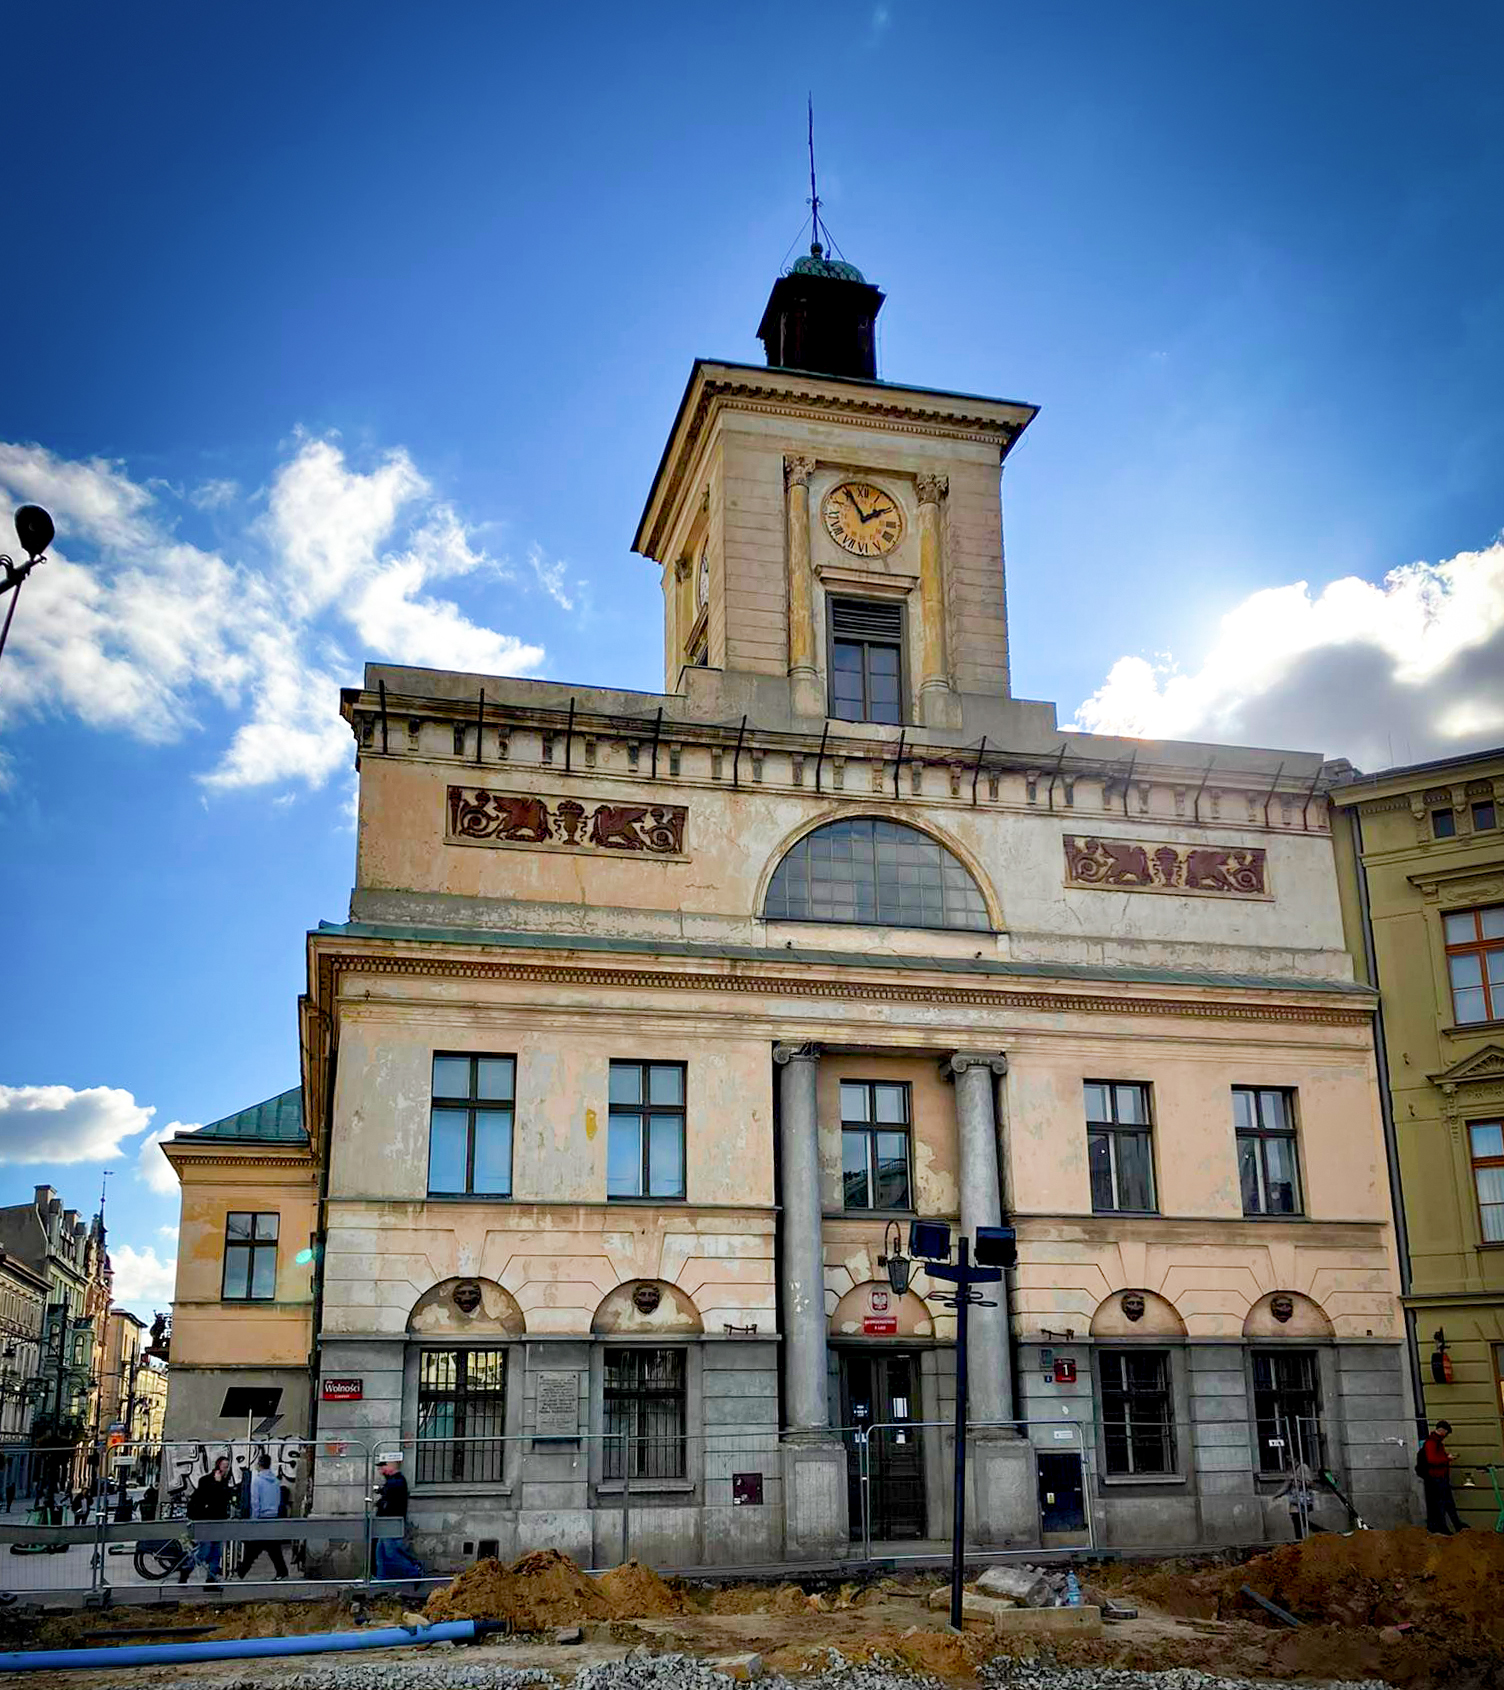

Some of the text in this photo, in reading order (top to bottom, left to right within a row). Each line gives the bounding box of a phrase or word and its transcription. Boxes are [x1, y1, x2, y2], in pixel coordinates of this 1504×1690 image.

[857, 486, 869, 498] XII
[842, 534, 856, 549] VII
[858, 542, 868, 552] VI
[873, 540, 882, 552] V
[1063, 1364, 1069, 1376] 1
